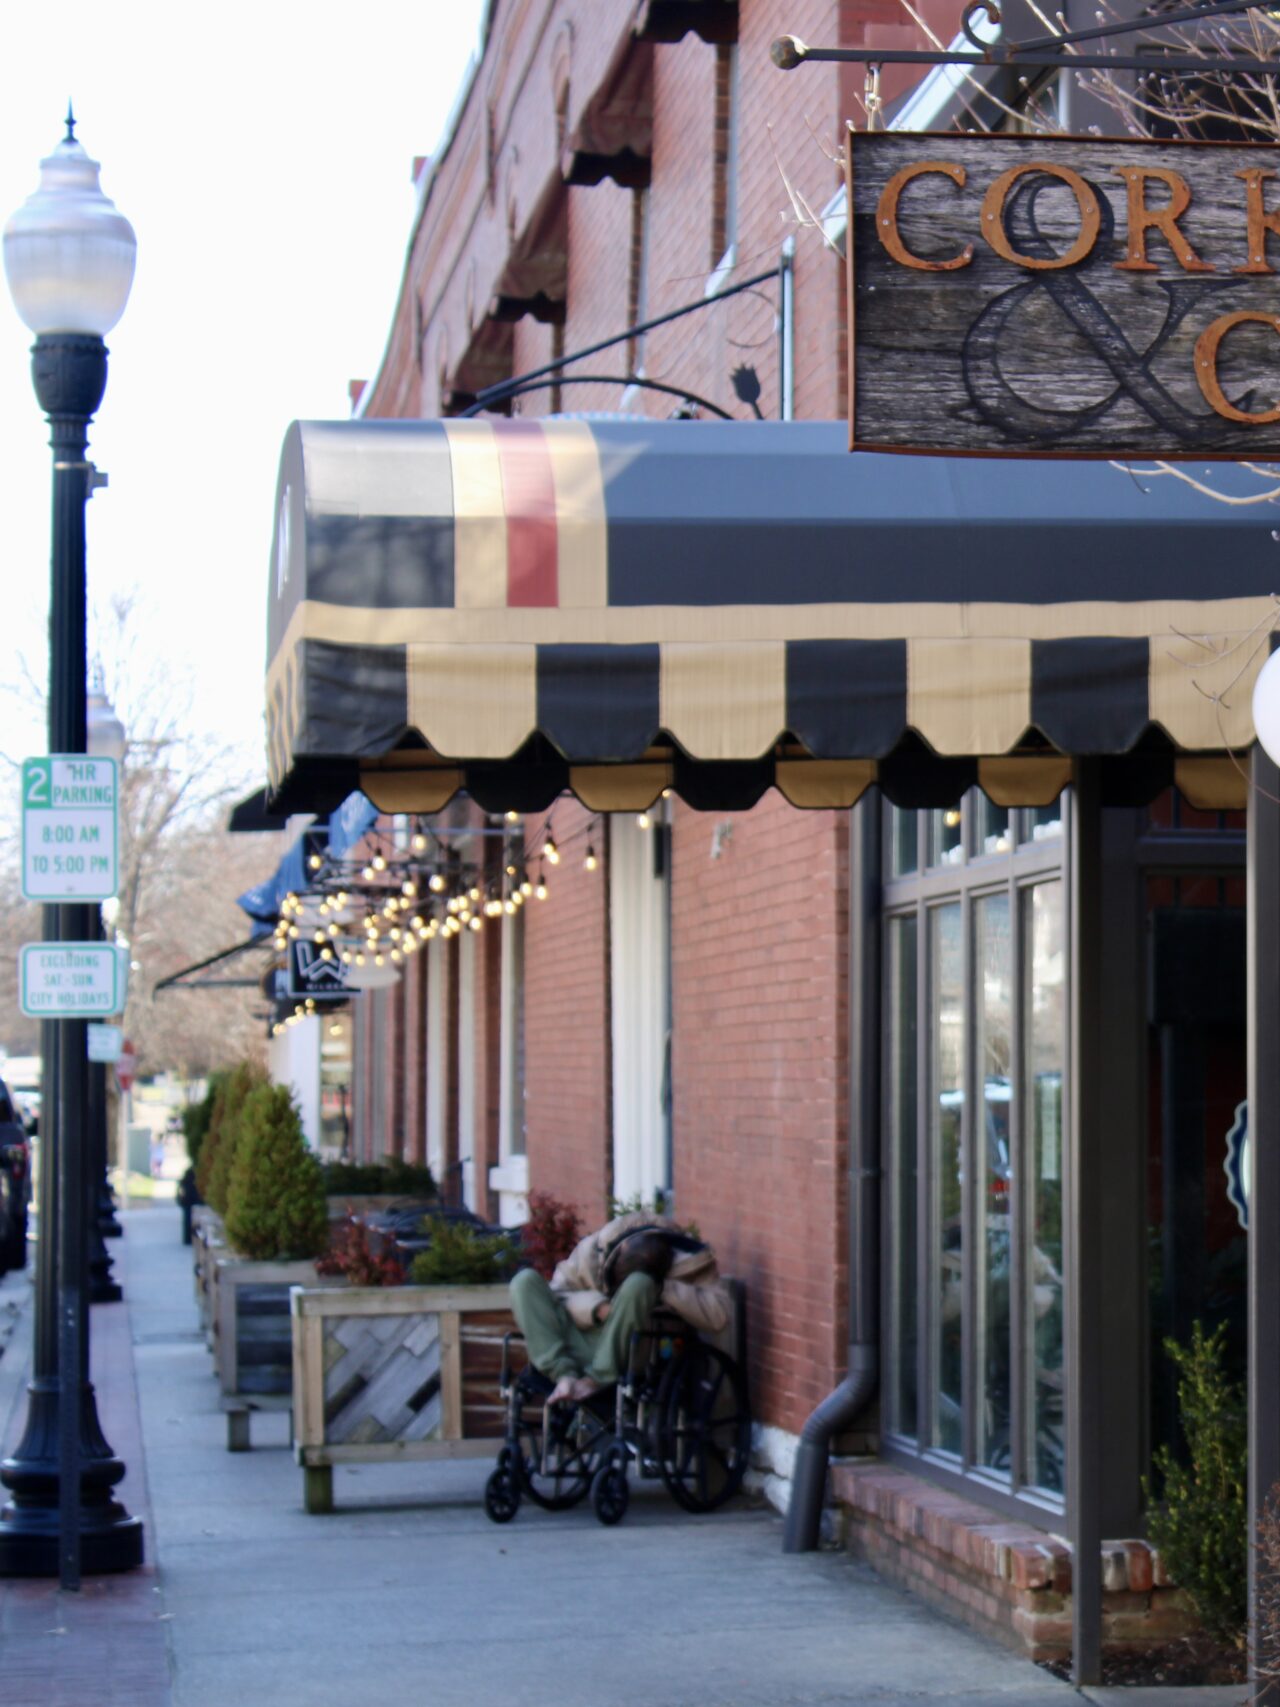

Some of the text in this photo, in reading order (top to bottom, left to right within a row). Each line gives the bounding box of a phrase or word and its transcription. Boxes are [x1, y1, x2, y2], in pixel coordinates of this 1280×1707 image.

[26, 764, 96, 802] 2 HR
[53, 786, 112, 804] PARKING
[42, 825, 100, 843] 8:00 AM
[33, 856, 109, 873] TO 5:00 PM
[40, 954, 99, 968] EXCLUDING
[30, 992, 110, 1005] CITY HOLIDAYS
